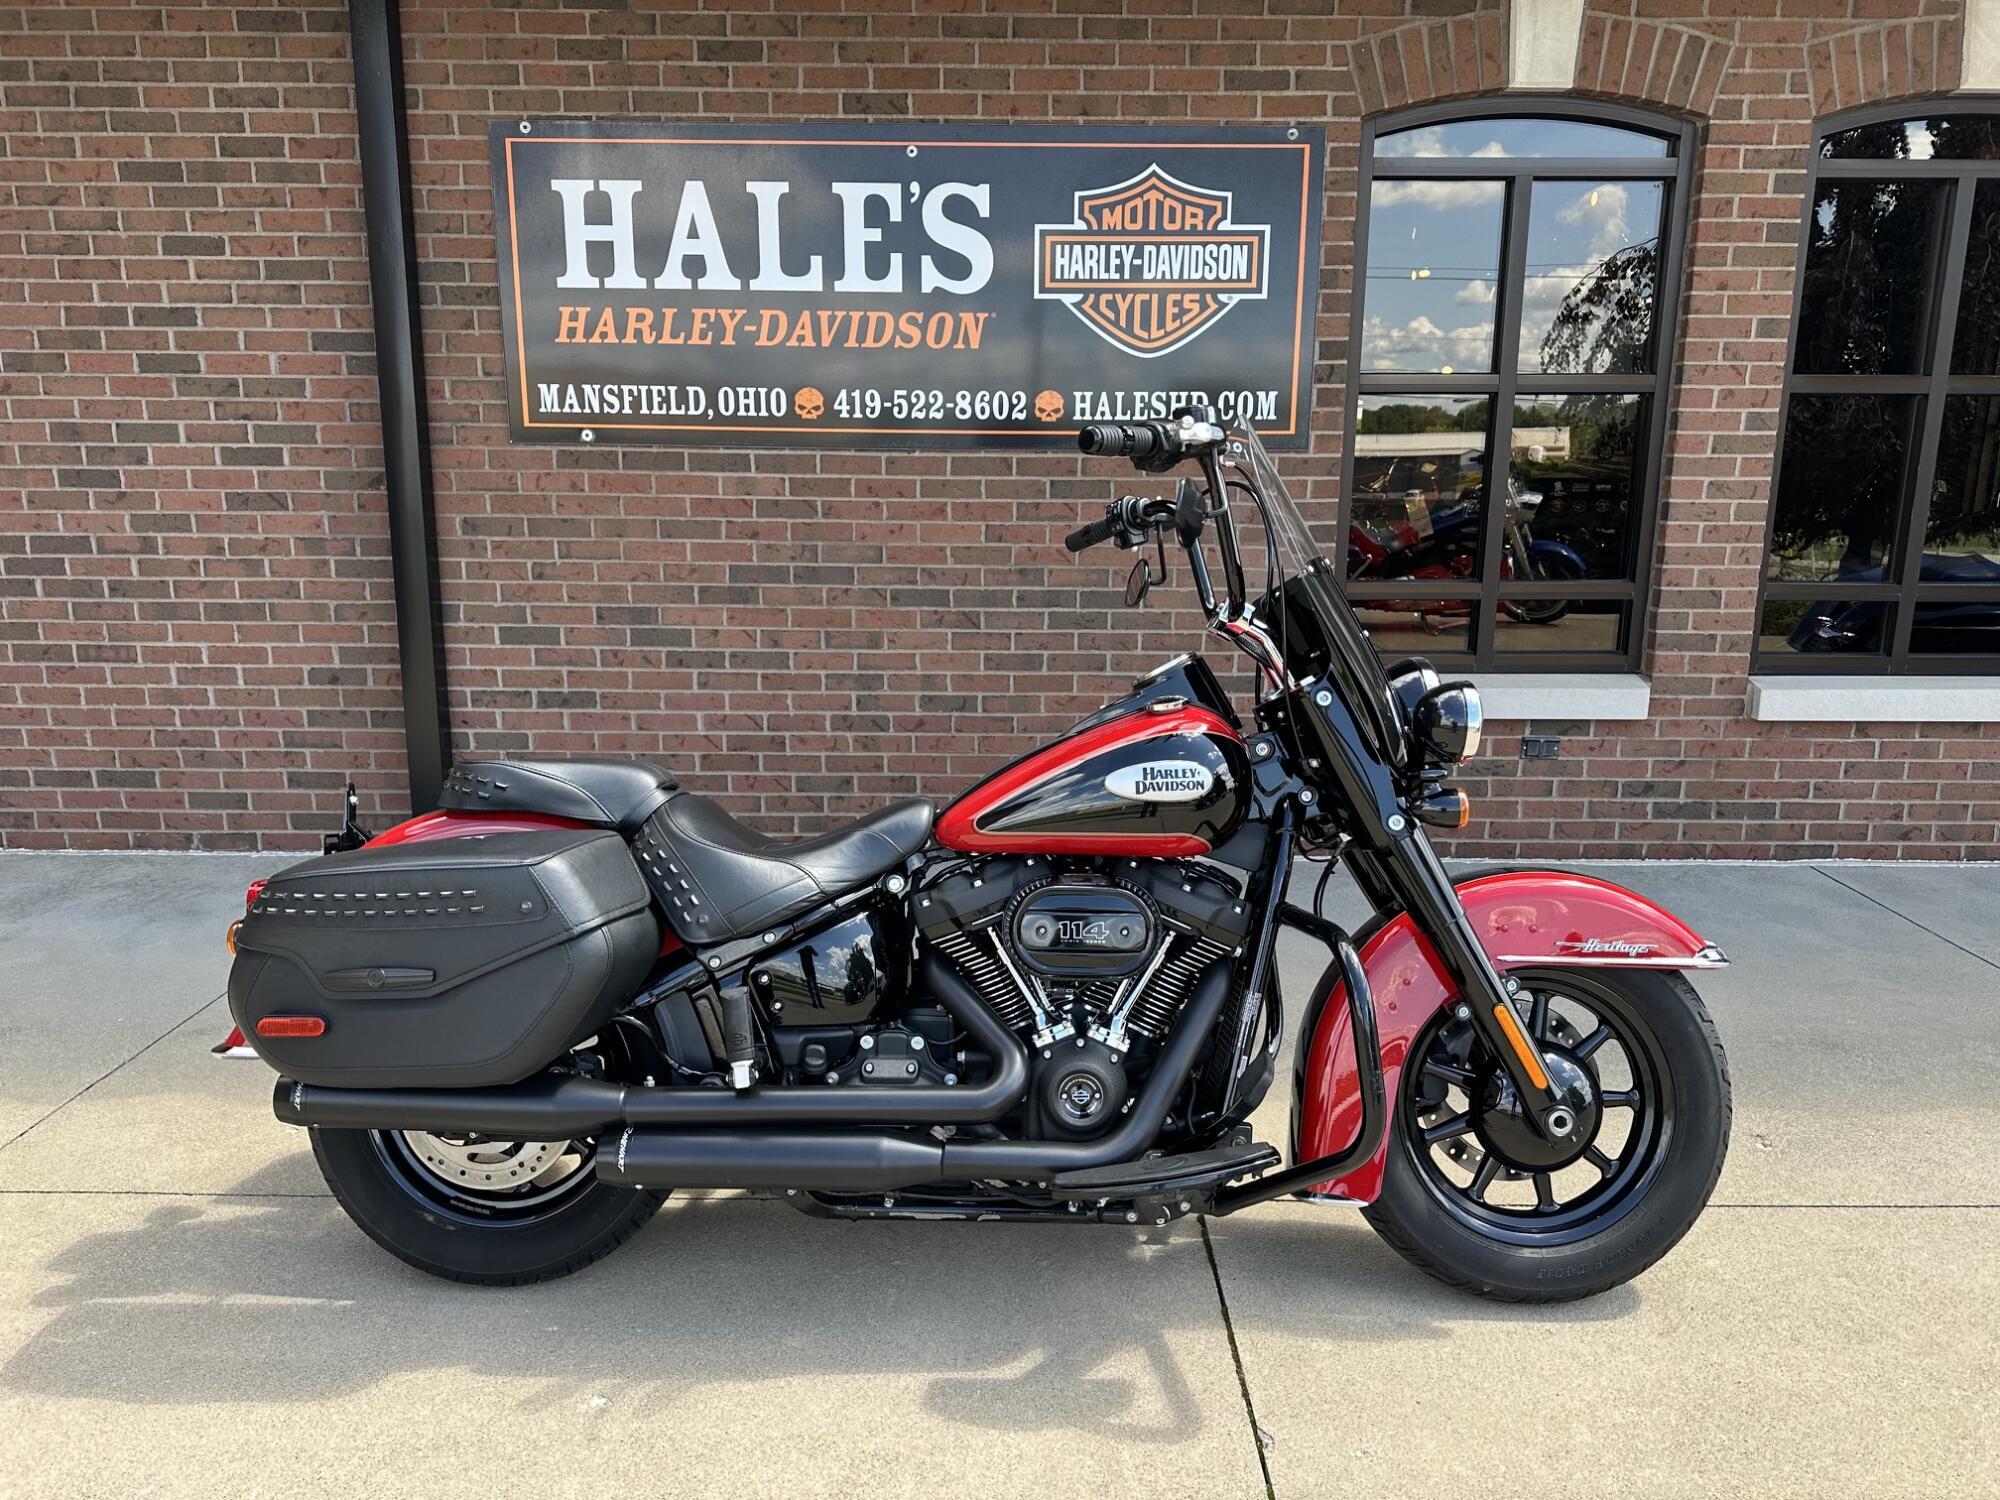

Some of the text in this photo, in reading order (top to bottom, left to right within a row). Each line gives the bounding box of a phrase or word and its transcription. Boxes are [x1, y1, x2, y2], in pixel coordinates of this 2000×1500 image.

[1101, 188, 1205, 231] MOTOR
[550, 178, 995, 296] HALE'S
[1054, 243, 1249, 281] HARLEY-DAVIDSON
[554, 306, 990, 350] HARLEY-DAVIDSON
[1099, 293, 1201, 340] CYCLES
[833, 388, 1028, 421] 419-522-8602
[1135, 780, 1205, 795] DAVIDSON
[1059, 920, 1110, 940] 114
[1581, 937, 1650, 957] Heritage
